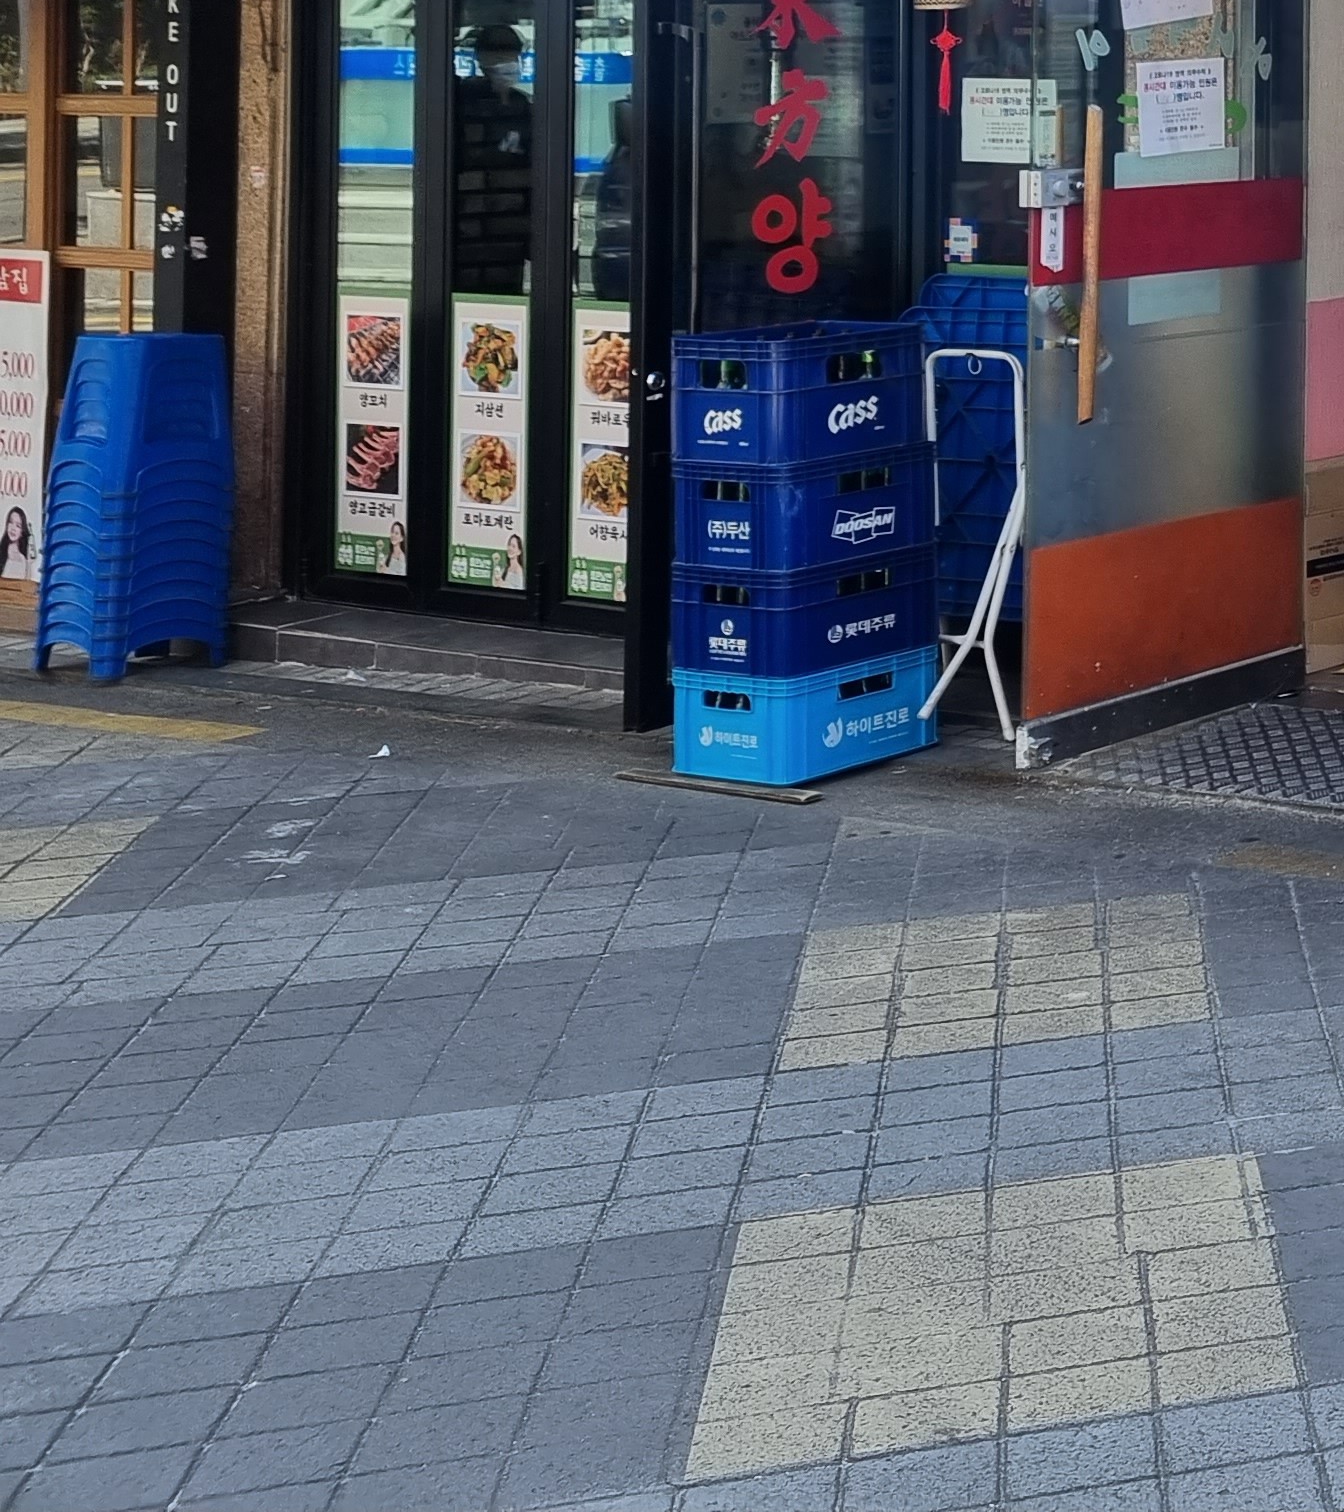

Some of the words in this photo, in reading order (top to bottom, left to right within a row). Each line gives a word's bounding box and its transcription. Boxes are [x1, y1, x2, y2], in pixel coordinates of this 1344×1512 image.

[165, 63, 180, 143] OUT
[358, 392, 388, 409] 양꼬치
[474, 402, 505, 419] 지삼선
[703, 408, 743, 436] Cass
[827, 394, 880, 435] Cass
[462, 513, 514, 531] 토마토계란
[707, 519, 751, 541] (주)두산
[834, 511, 894, 536] DOOSAN
[845, 612, 897, 638] 롯데주류
[845, 706, 910, 738] 하이트진로
[714, 731, 759, 749] 하이트진로
